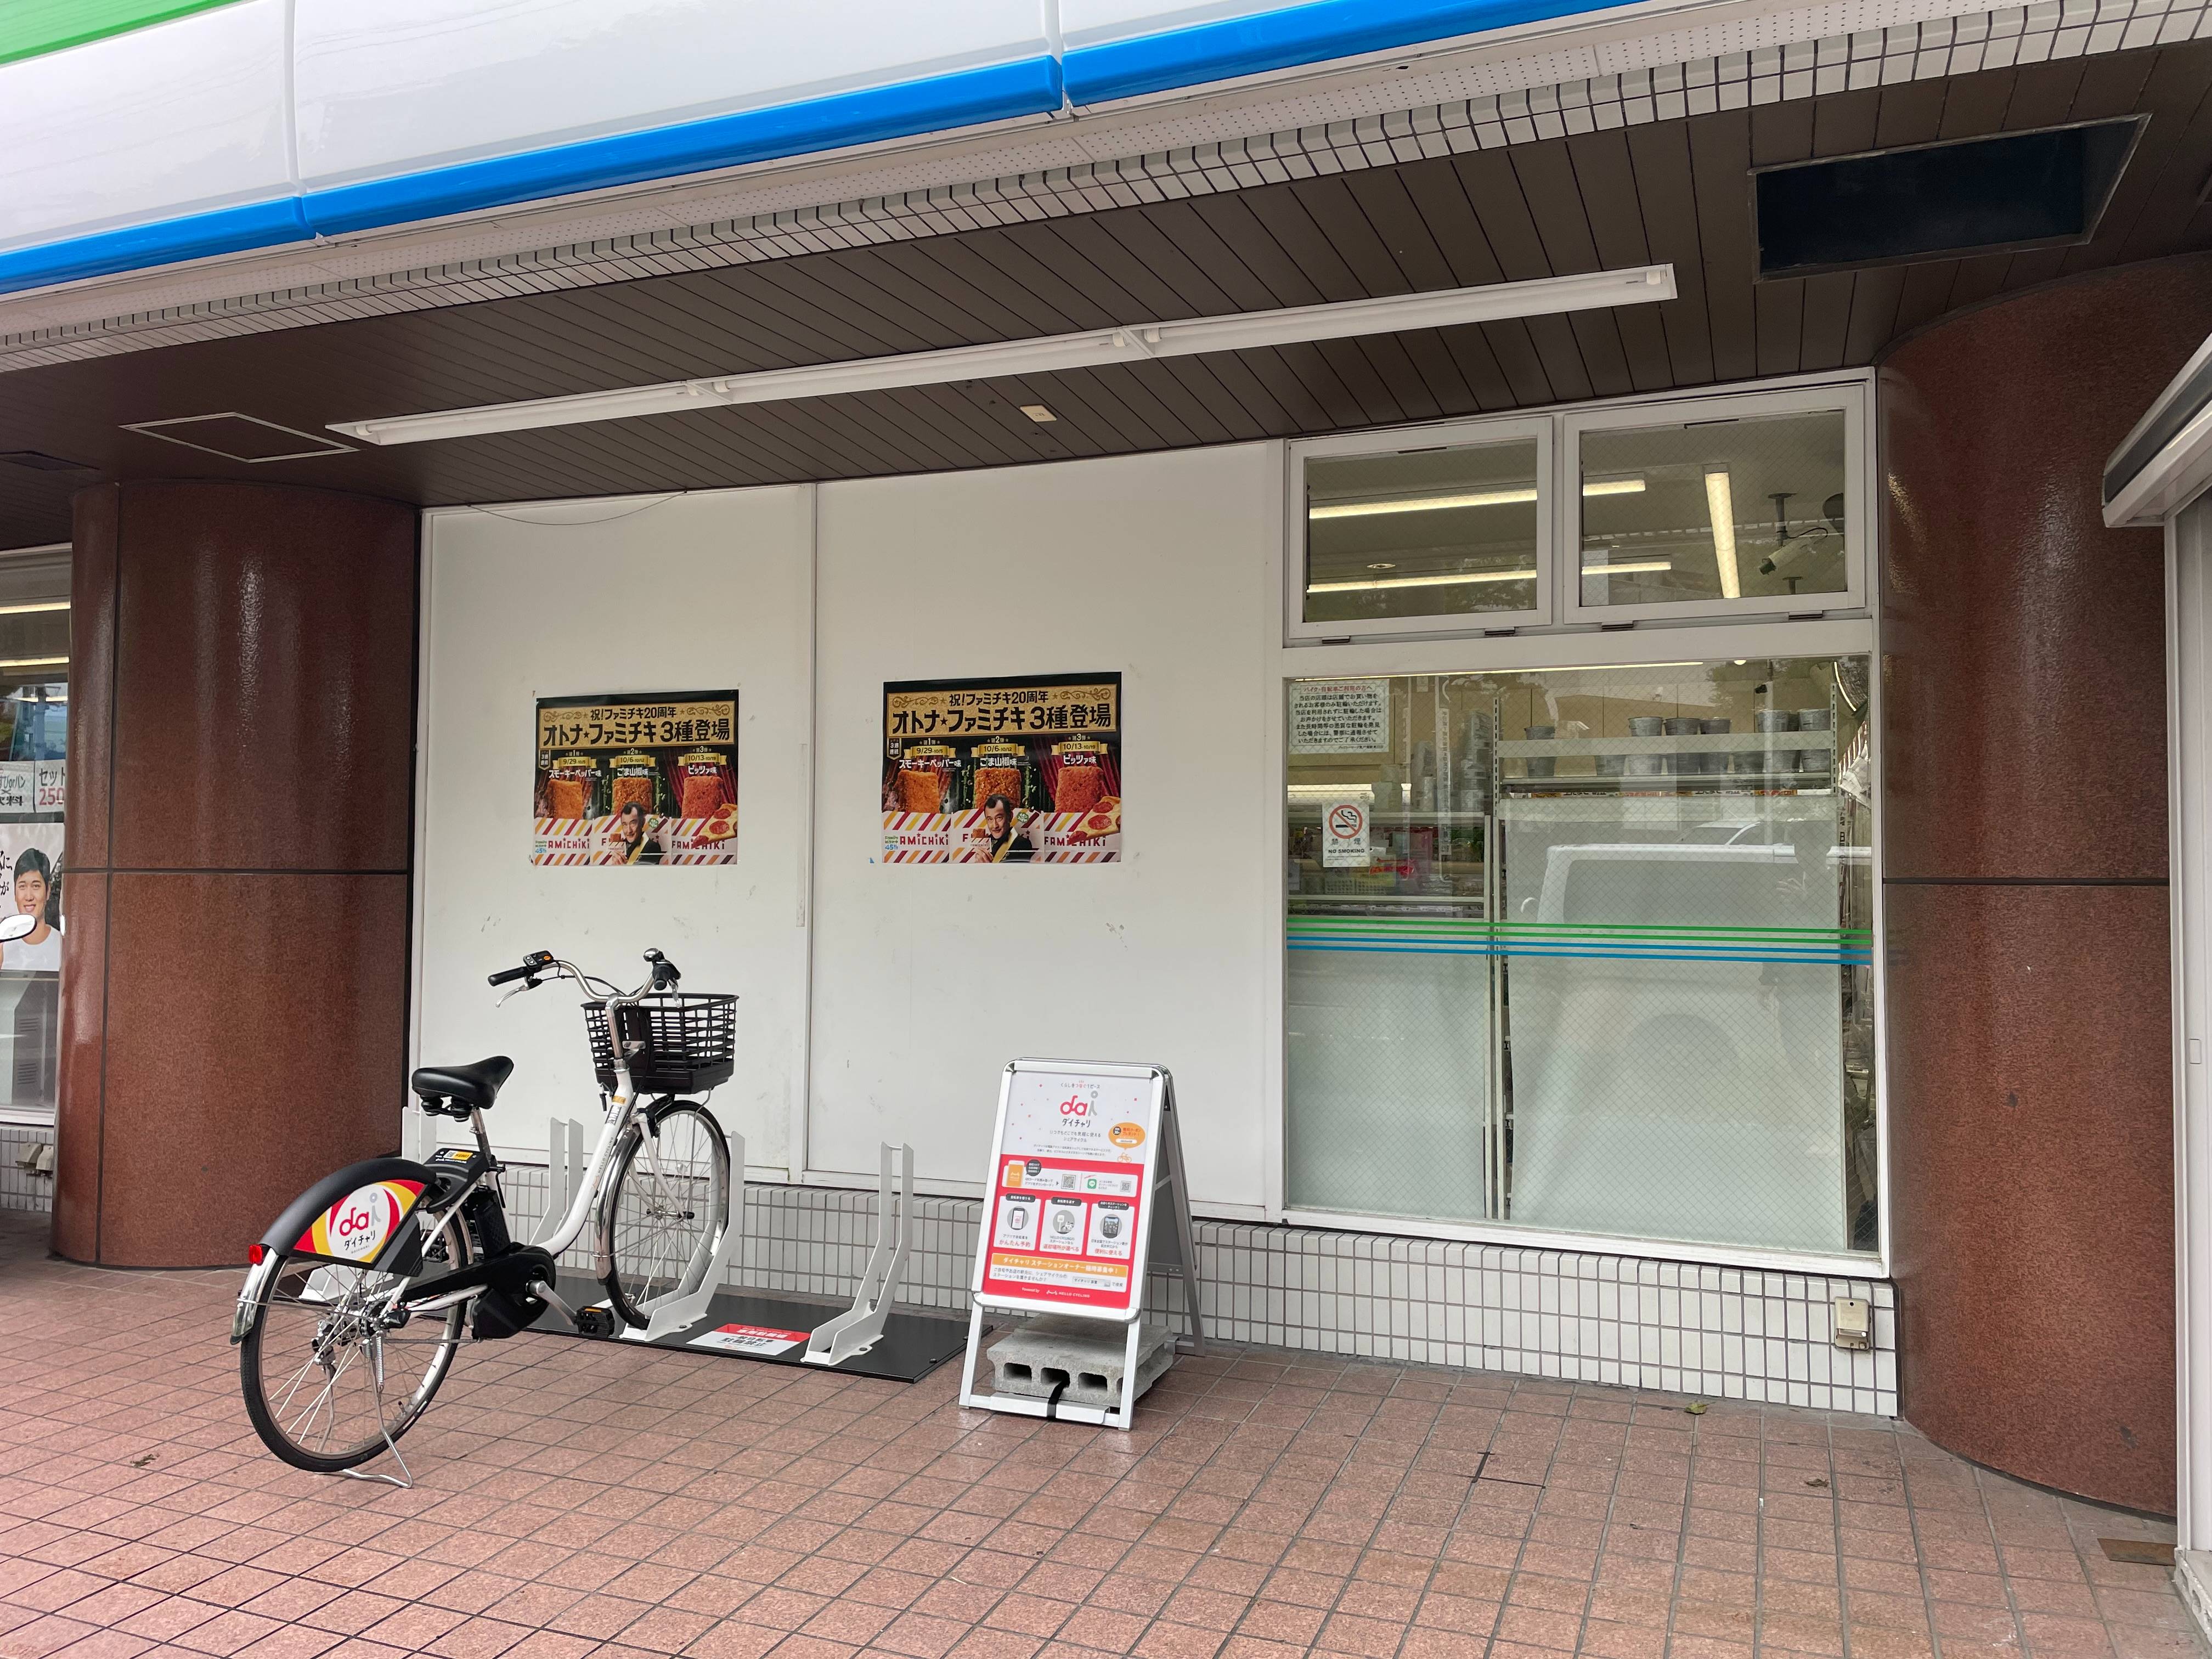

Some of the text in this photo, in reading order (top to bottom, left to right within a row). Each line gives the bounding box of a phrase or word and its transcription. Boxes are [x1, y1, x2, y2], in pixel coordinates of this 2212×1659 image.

[899, 759, 962, 769] スモーキーペッパー味
[1063, 754, 1097, 765] ピッツァ味
[549, 769, 602, 778] スモーキーペッパー味
[688, 765, 717, 775] ピッツァ味
[1062, 1118, 1091, 1127] ダイチャリ
[345, 1230, 375, 1250] ダイチャリ
[999, 1239, 1031, 1248] かんたん予約
